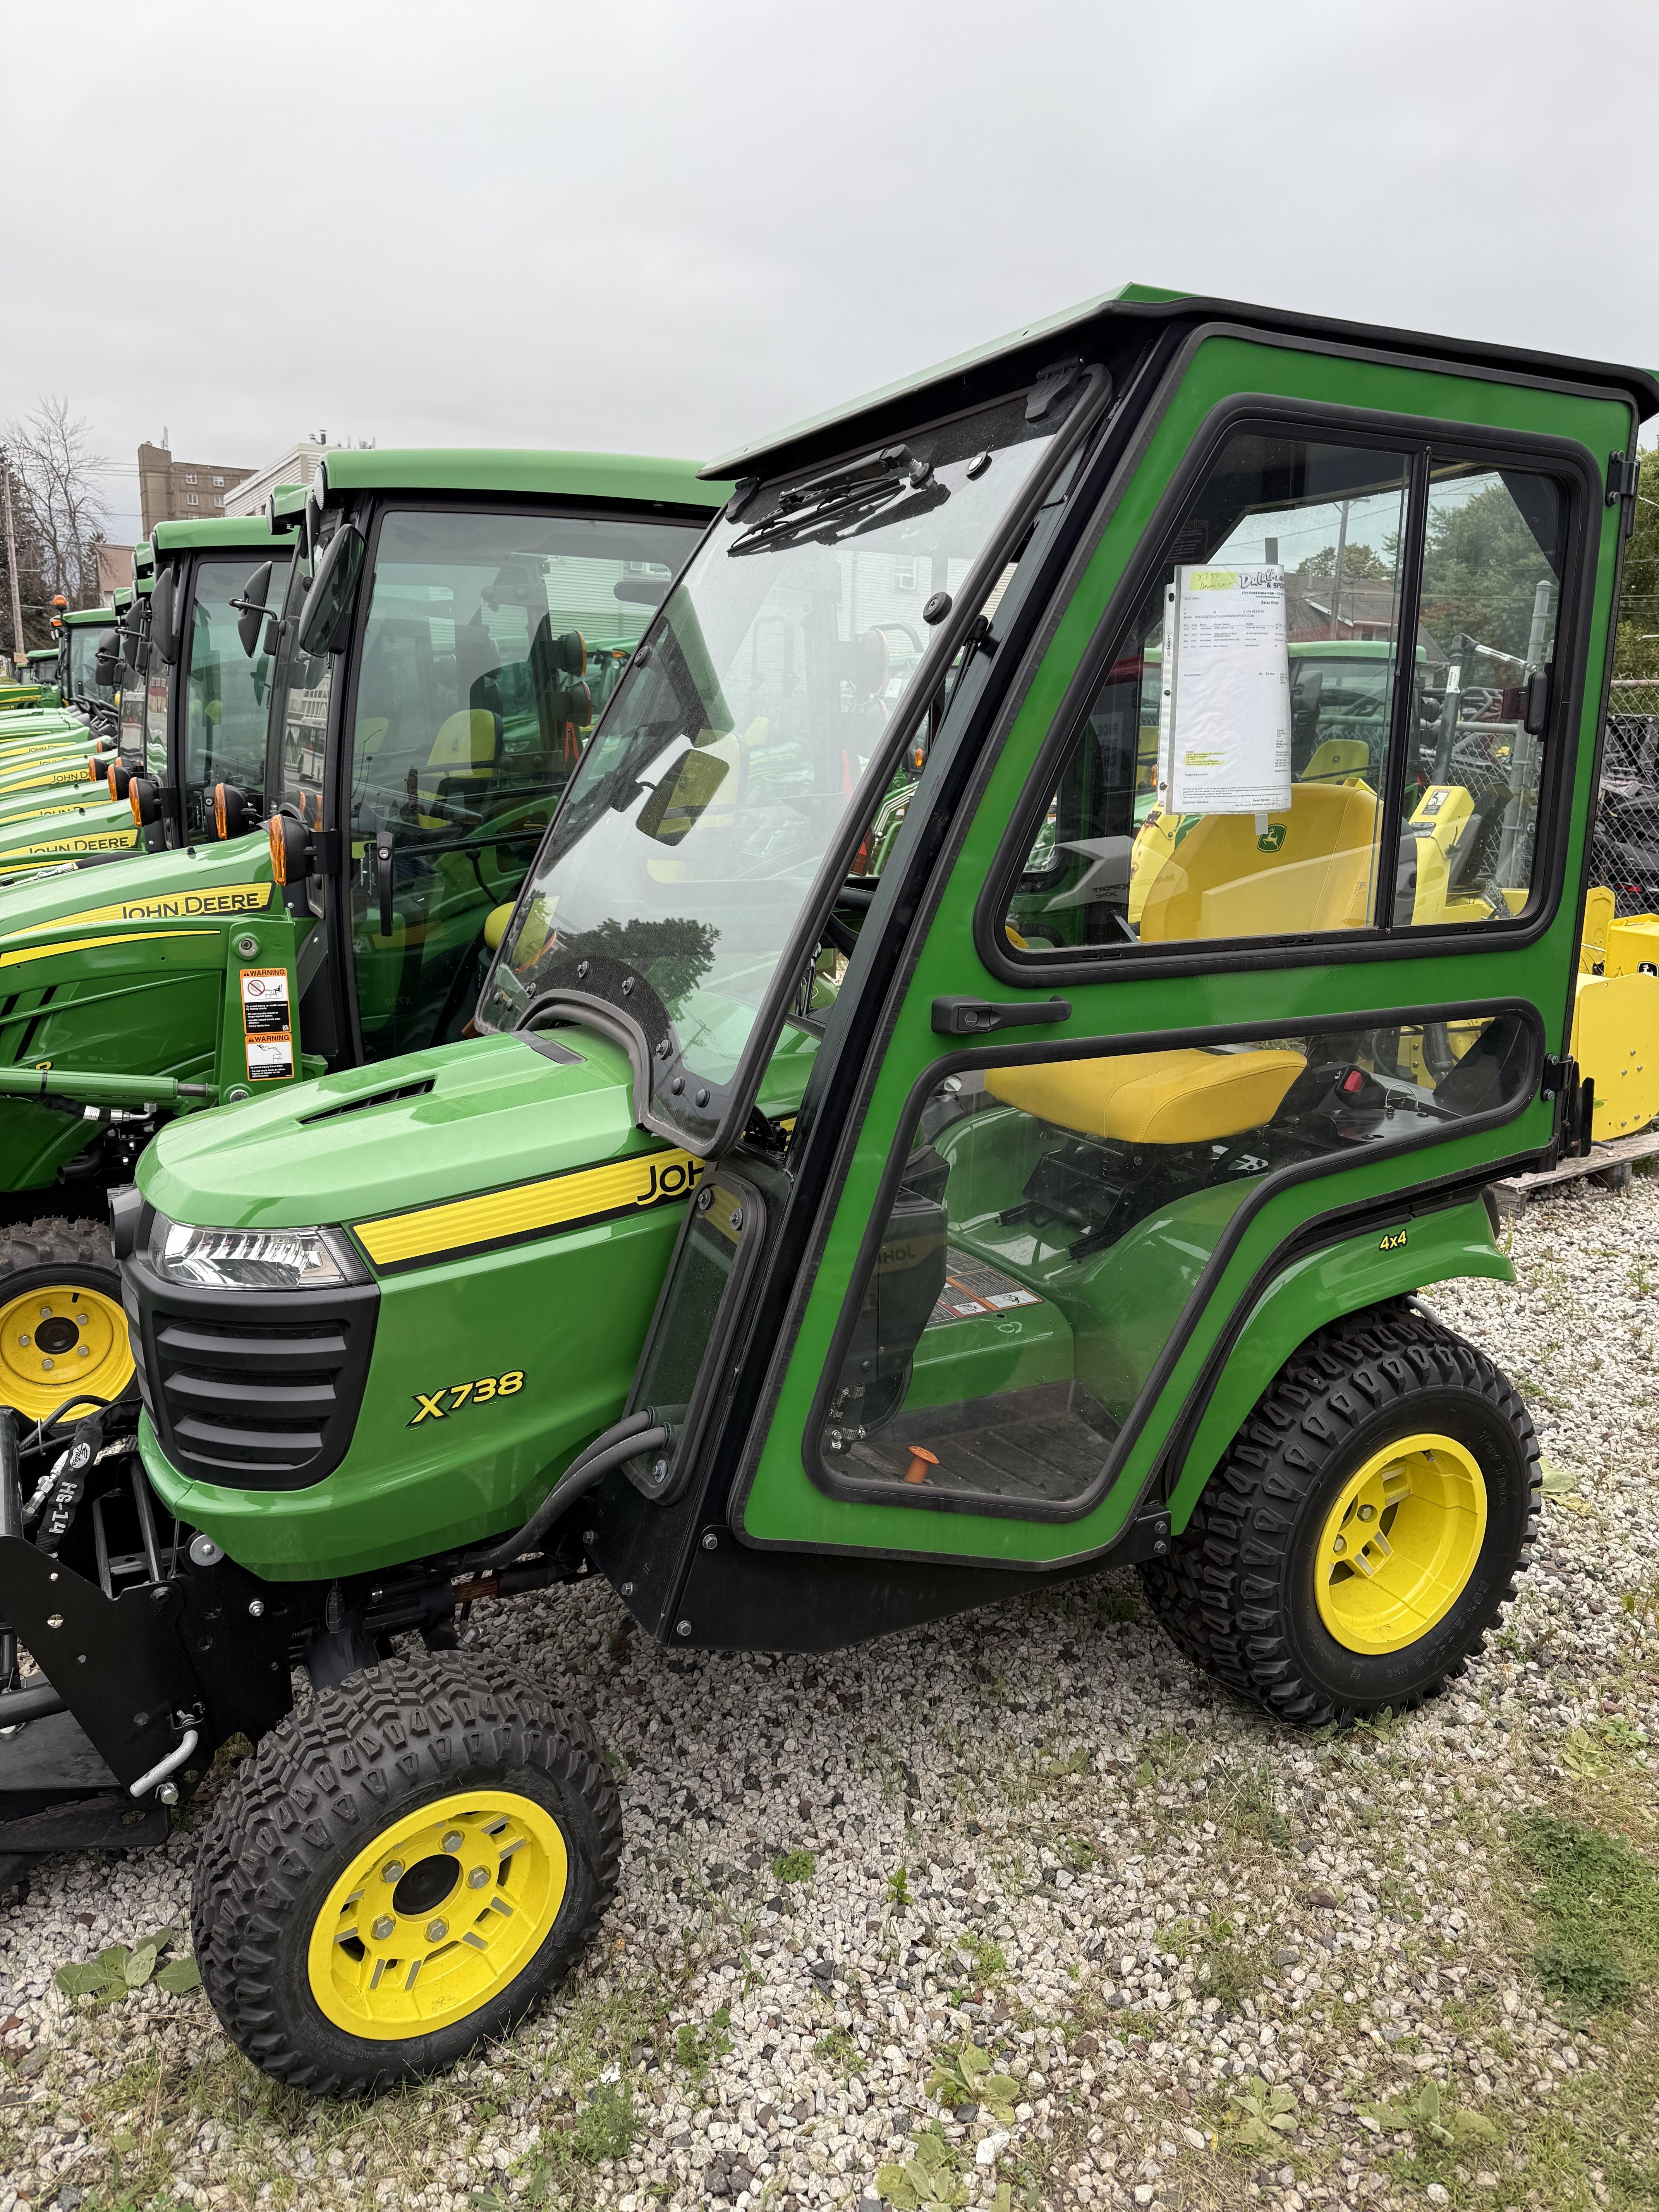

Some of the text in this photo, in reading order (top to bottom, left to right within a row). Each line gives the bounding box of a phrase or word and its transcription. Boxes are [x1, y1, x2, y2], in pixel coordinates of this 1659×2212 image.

[1239, 568, 1275, 589] Duluth
[51, 773, 77, 783] JOHN
[74, 836, 129, 851] DEERE
[122, 893, 259, 919] JOHN DEERE
[637, 1160, 704, 1202] JOH
[1380, 1230, 1407, 1250] 4x4
[409, 1370, 524, 1425] X738
